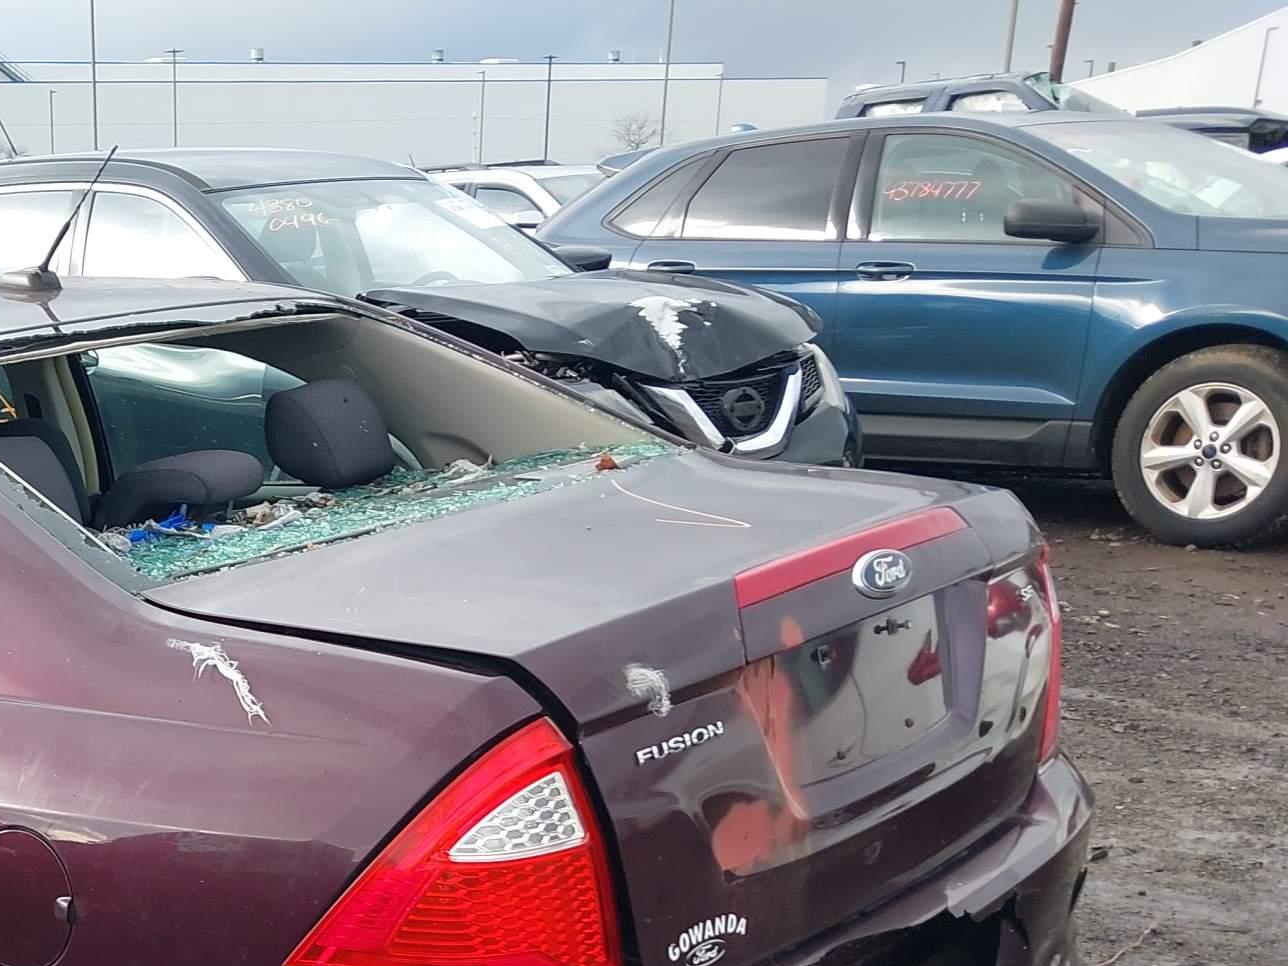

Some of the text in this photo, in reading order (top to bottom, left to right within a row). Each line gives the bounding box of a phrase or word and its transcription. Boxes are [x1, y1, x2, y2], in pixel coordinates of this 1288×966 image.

[248, 198, 313, 216] 4380
[873, 555, 908, 587] Ford
[635, 720, 724, 766] FUSION
[668, 913, 747, 962] GOWANDA
[692, 943, 720, 965] Ford
